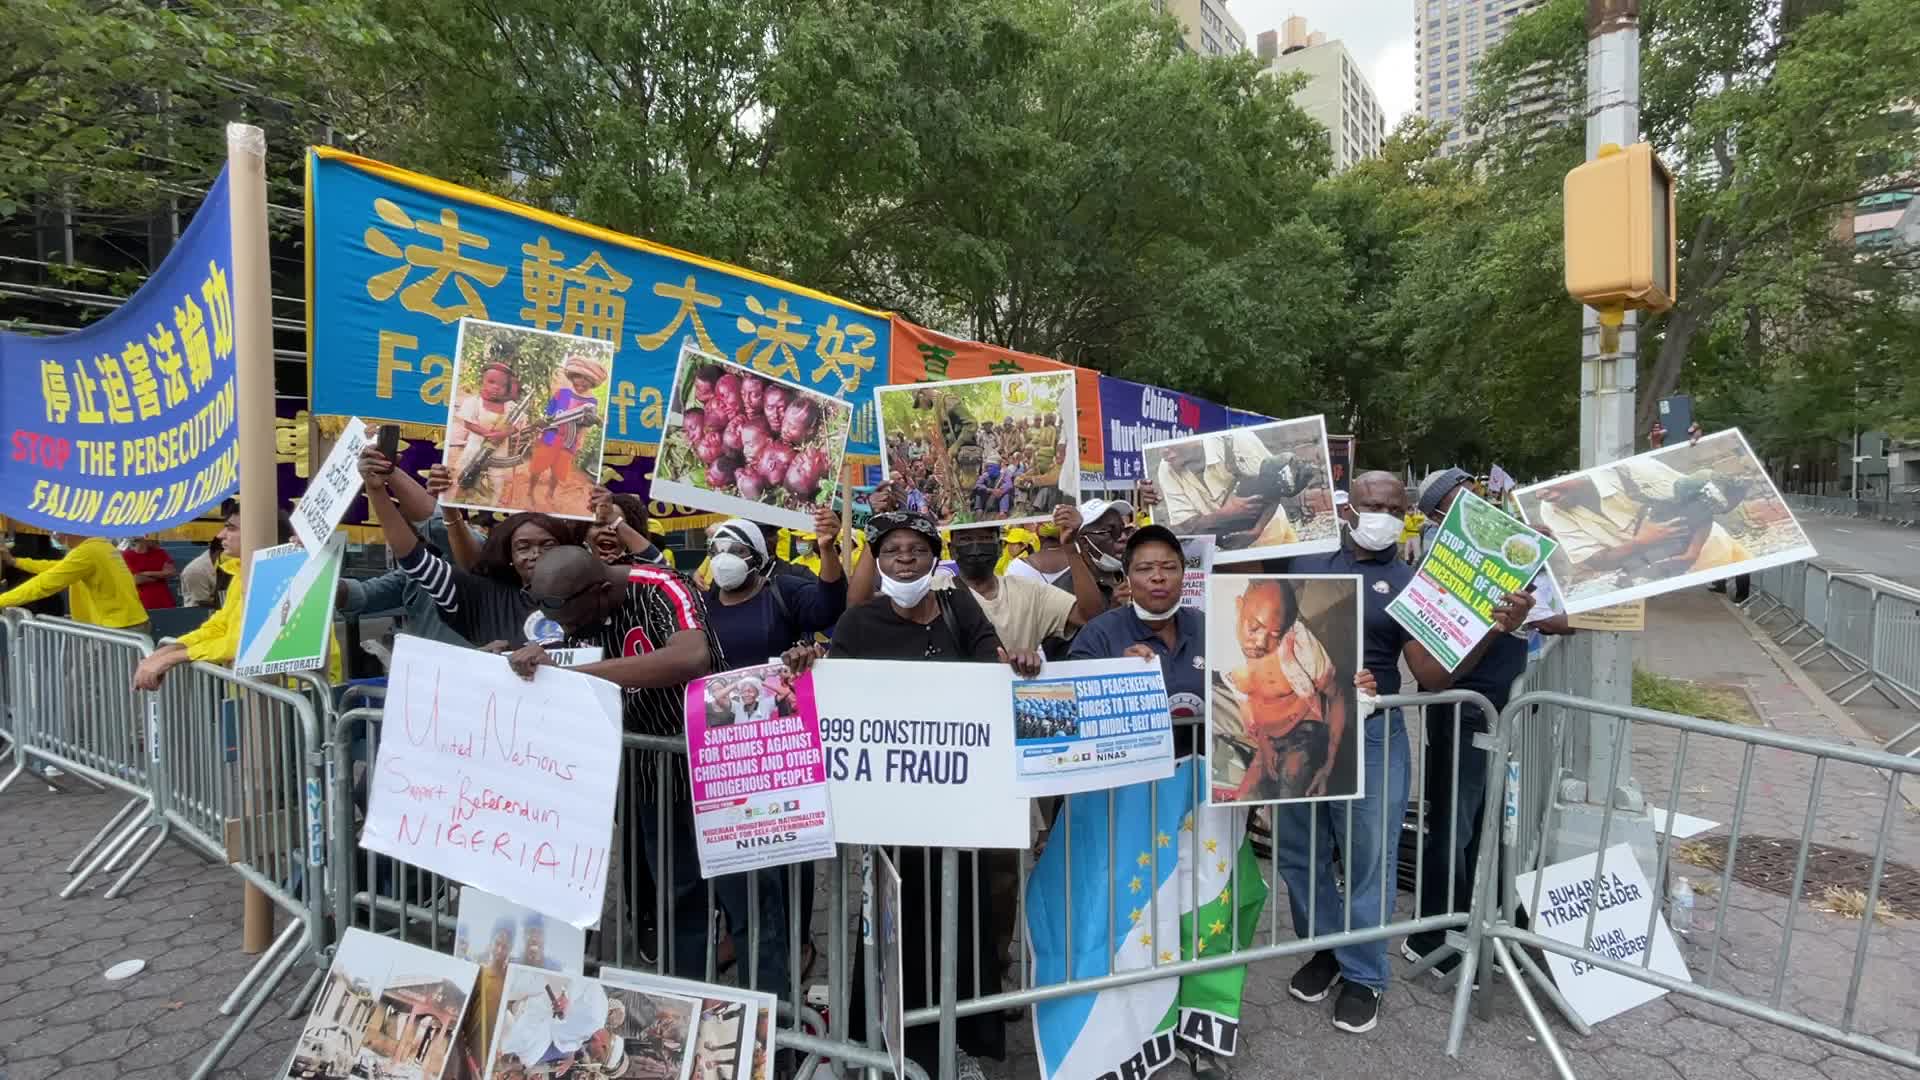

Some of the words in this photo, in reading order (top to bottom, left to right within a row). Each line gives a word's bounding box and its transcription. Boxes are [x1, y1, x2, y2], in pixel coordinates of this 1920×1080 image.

[40, 259, 233, 424] 停止迫害法輪功
[1142, 386, 1178, 423] China:
[11, 428, 71, 471] STOP
[76, 440, 116, 476] THE
[122, 375, 235, 477] PERSECUTION
[28, 479, 104, 524] FALUN
[101, 487, 163, 526] GONG
[156, 478, 190, 522] IN
[184, 438, 240, 513] CHINA
[1432, 543, 1477, 582] INVASION
[1473, 575, 1489, 594] OF
[1440, 530, 1466, 552] STOP
[1463, 545, 1485, 568] THE
[1480, 558, 1522, 593] FULANI
[1425, 558, 1478, 605] ANCESTRAL
[1416, 610, 1450, 641] NINAS
[236, 665, 264, 677] GLOBAL
[265, 657, 321, 673] DIRECTORATE
[1075, 679, 1102, 699] SEND
[1101, 674, 1165, 697] PEACEKEEPING
[405, 663, 473, 758] United
[482, 691, 577, 781] Nations
[1078, 698, 1112, 718] FORCES
[1111, 697, 1124, 714] TO
[1123, 695, 1140, 713] THE
[1140, 692, 1168, 711] SOUTH
[703, 723, 758, 746] SANCTION
[760, 716, 804, 738] NIGERIA
[859, 718, 991, 748] CONSTITUTION
[1080, 719, 1098, 739] AND
[694, 757, 758, 783] CHRISTIANS
[760, 754, 784, 773] AND
[785, 748, 821, 768] OTHER
[698, 746, 720, 765] FOR
[722, 740, 764, 761] CRIMES
[766, 732, 812, 754] AGAINST
[1097, 750, 1127, 761] NINAS
[705, 774, 772, 799] INDIGENOUS
[773, 767, 815, 788] PEOPLE
[825, 747, 849, 781] IS
[855, 748, 872, 782] A
[884, 750, 970, 785] FRAUD
[736, 831, 798, 850] NINAS
[1541, 897, 1593, 928] TYRANT
[1597, 883, 1642, 912] LEADER
[1548, 878, 1595, 907] BUHARI
[1611, 872, 1624, 887] A
[1602, 934, 1648, 961] URDERER
